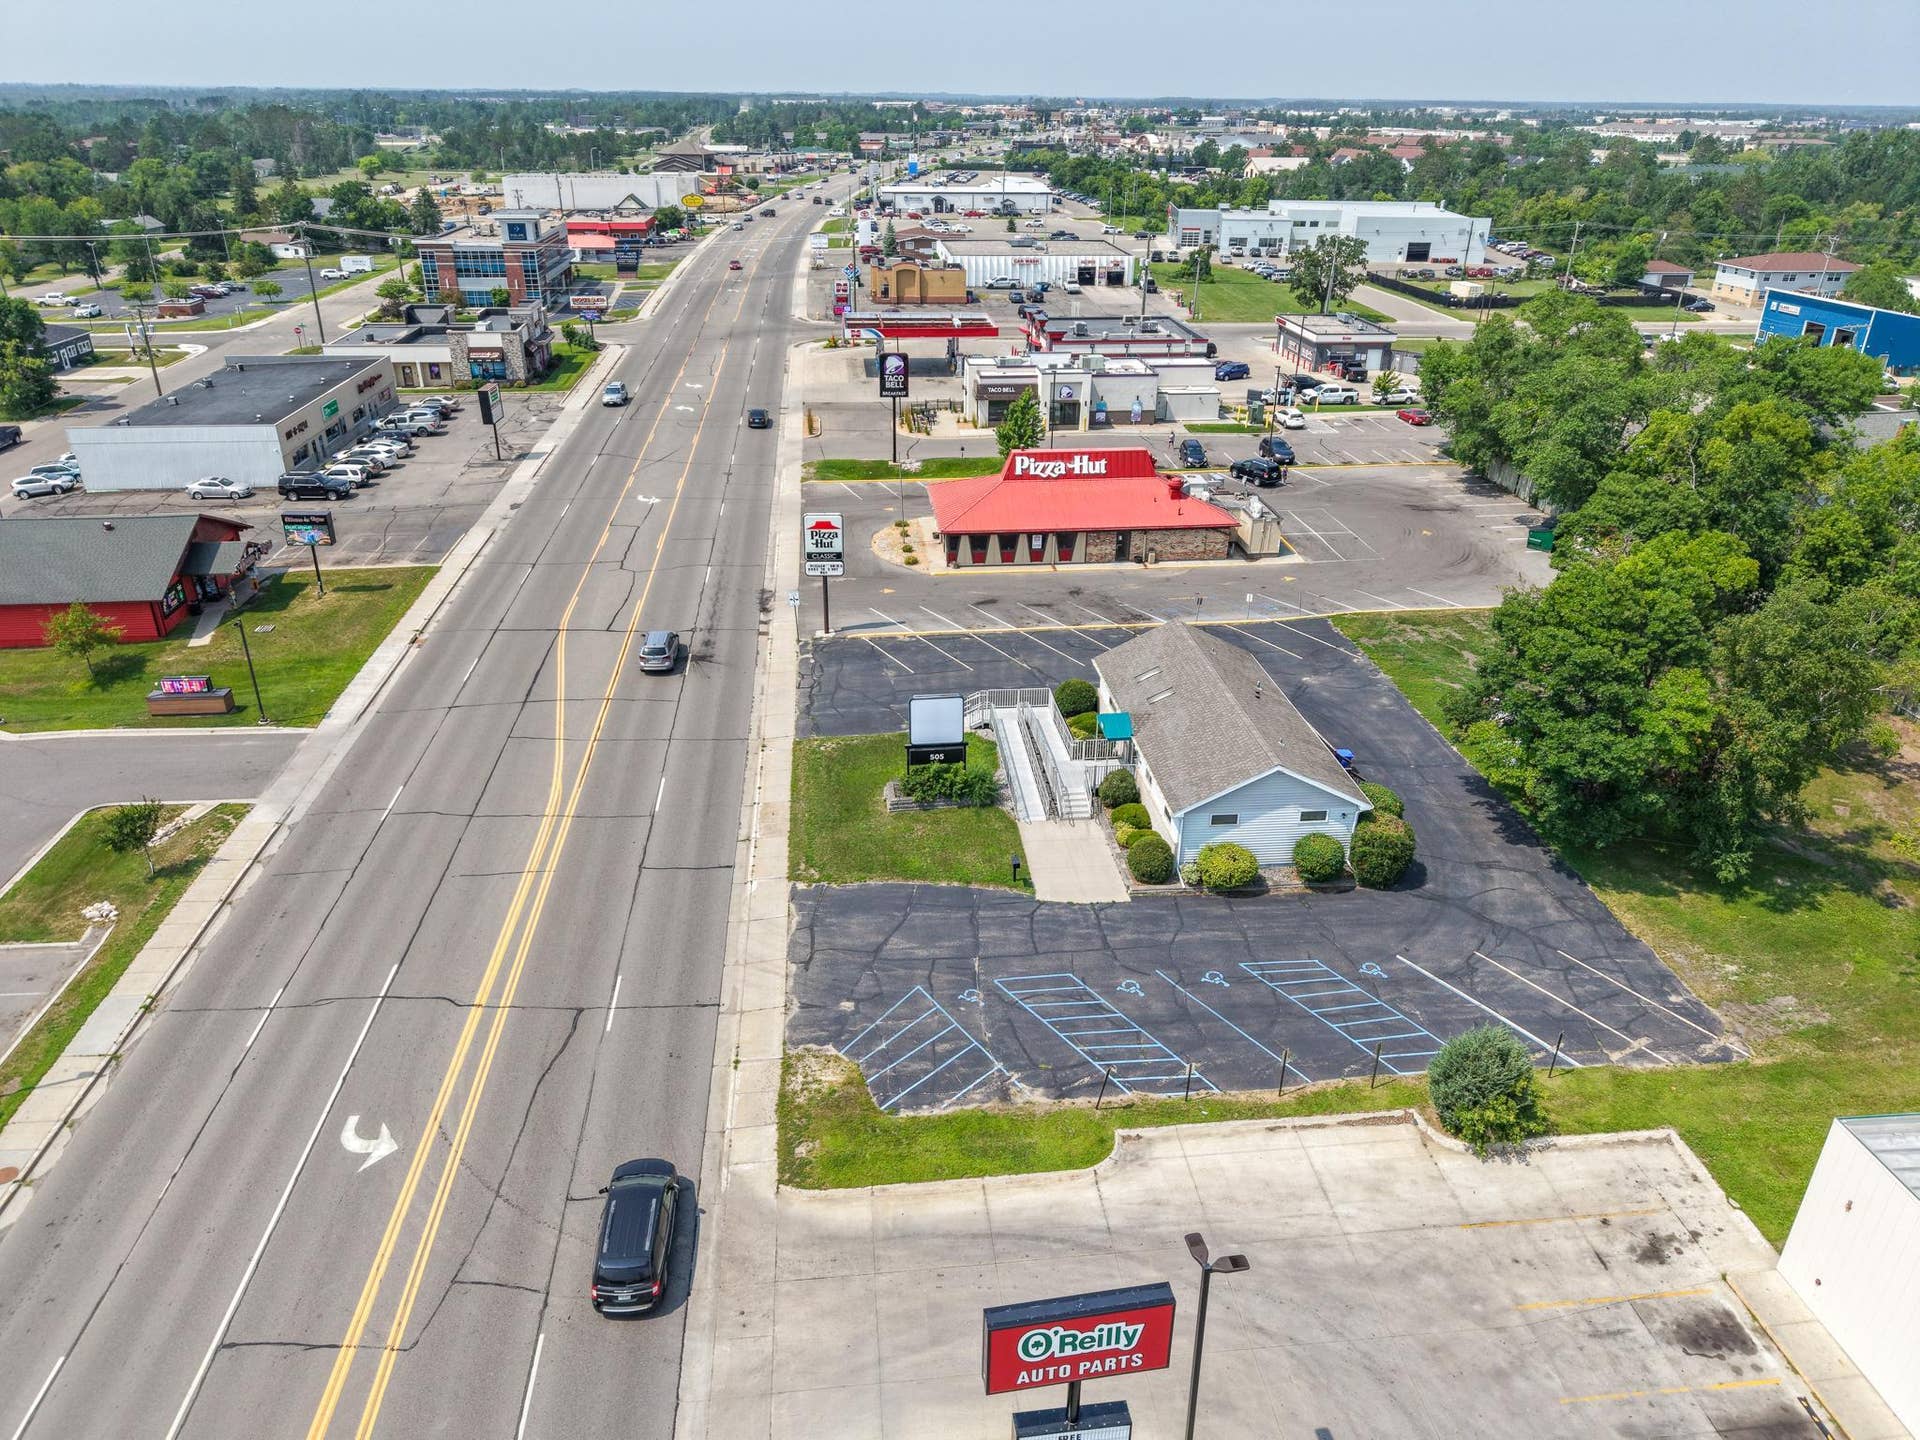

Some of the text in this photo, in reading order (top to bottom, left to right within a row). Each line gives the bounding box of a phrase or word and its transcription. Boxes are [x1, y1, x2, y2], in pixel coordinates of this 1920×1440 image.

[1014, 454, 1108, 477] Pizza Hut
[811, 530, 838, 540] Pizza
[811, 539, 833, 548] Hut
[1019, 1324, 1143, 1360] O'Reilly
[1016, 1353, 1144, 1385] AUTO PARTS
